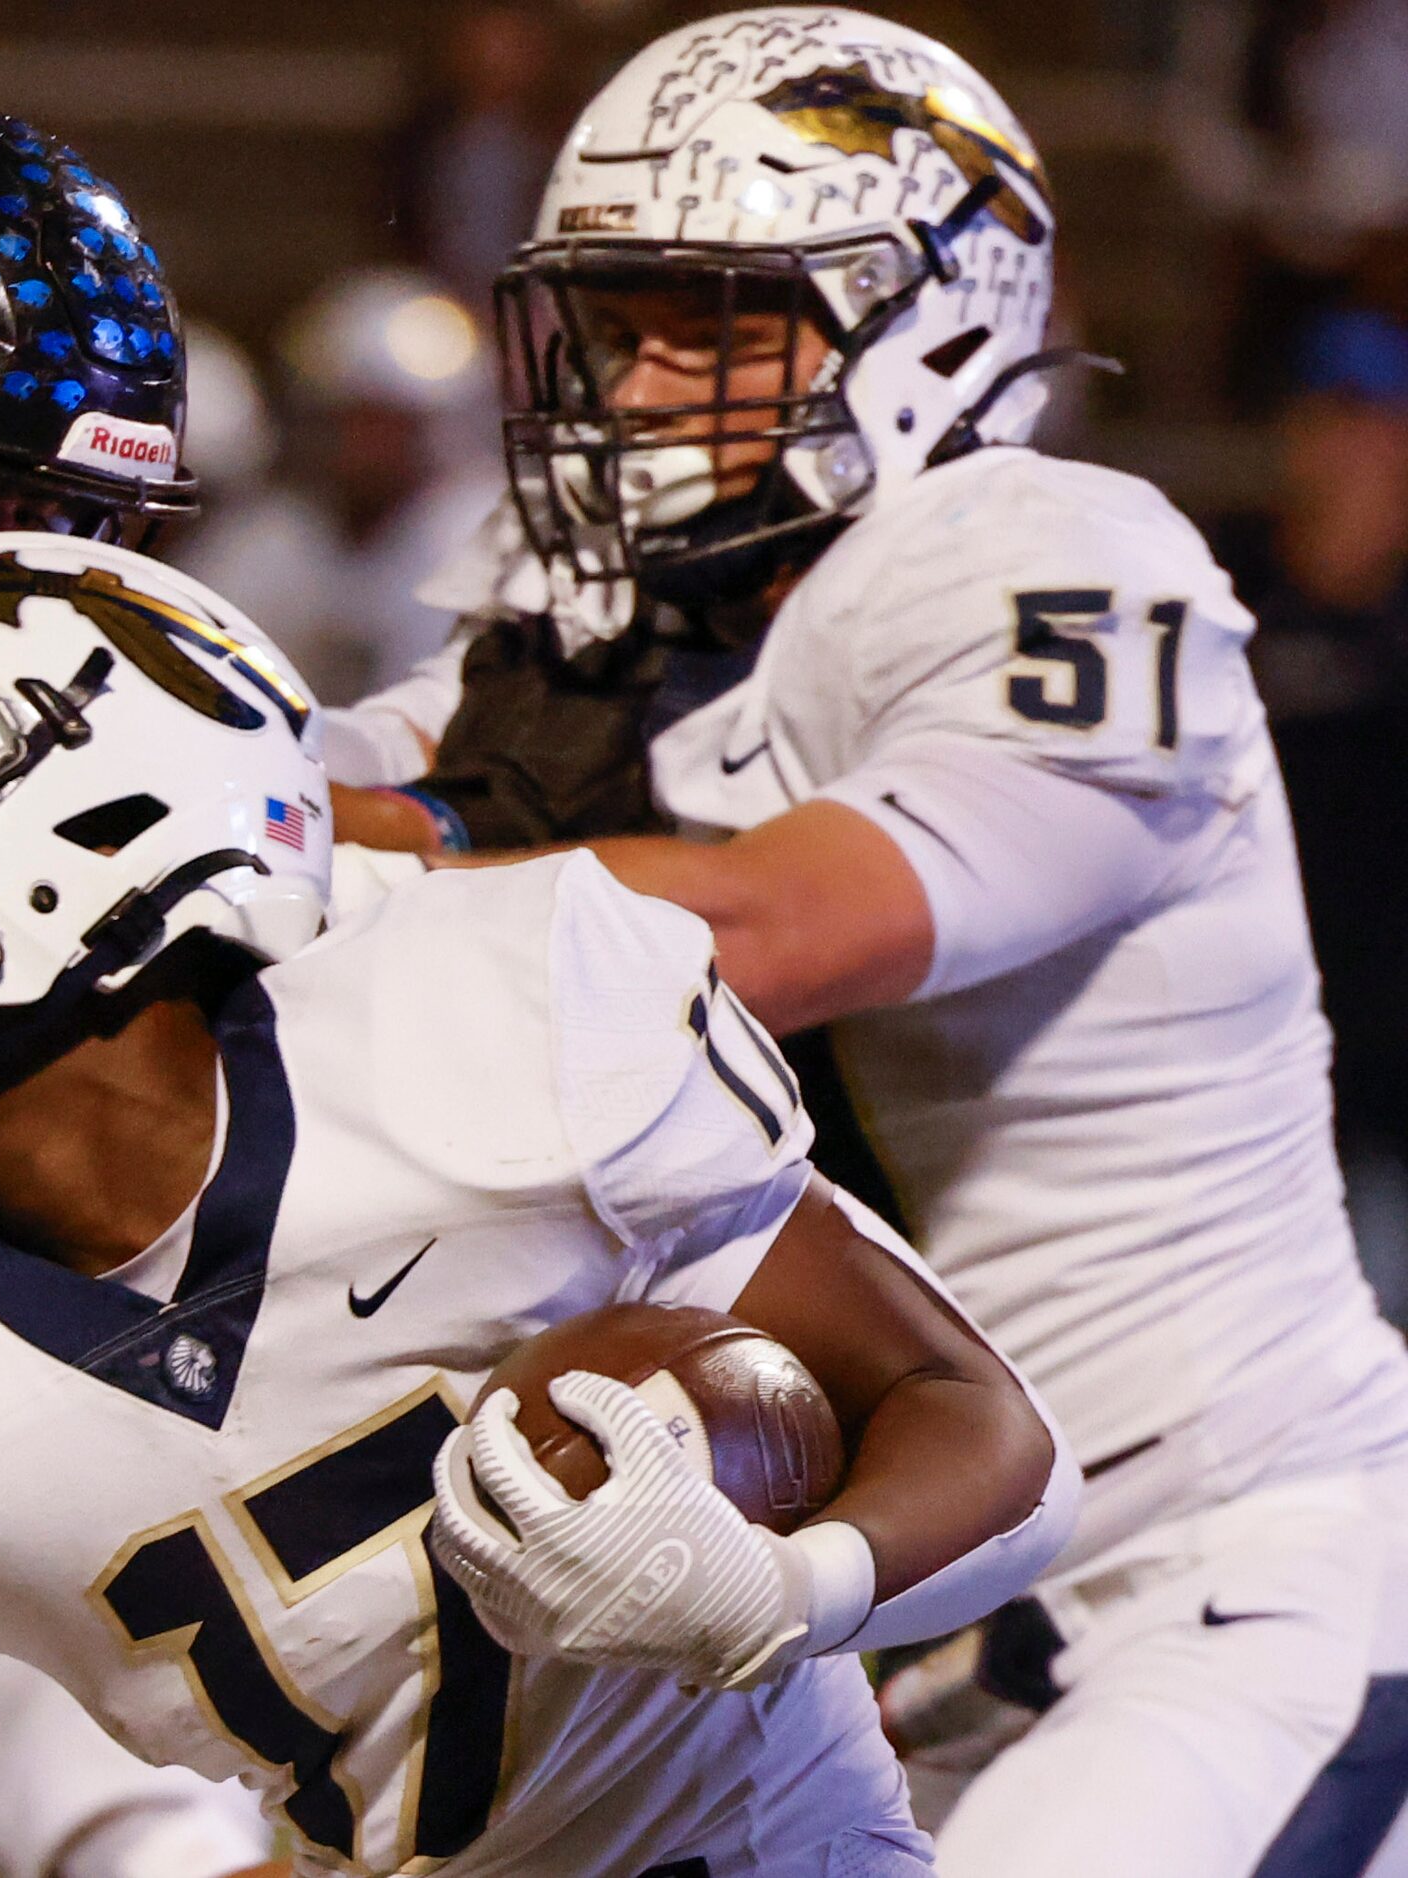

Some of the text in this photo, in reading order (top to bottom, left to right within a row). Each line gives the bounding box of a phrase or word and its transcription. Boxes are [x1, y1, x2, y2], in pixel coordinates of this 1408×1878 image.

[90, 425, 170, 464] Riddell
[1006, 587, 1190, 754] 51
[85, 1371, 521, 1868] 17
